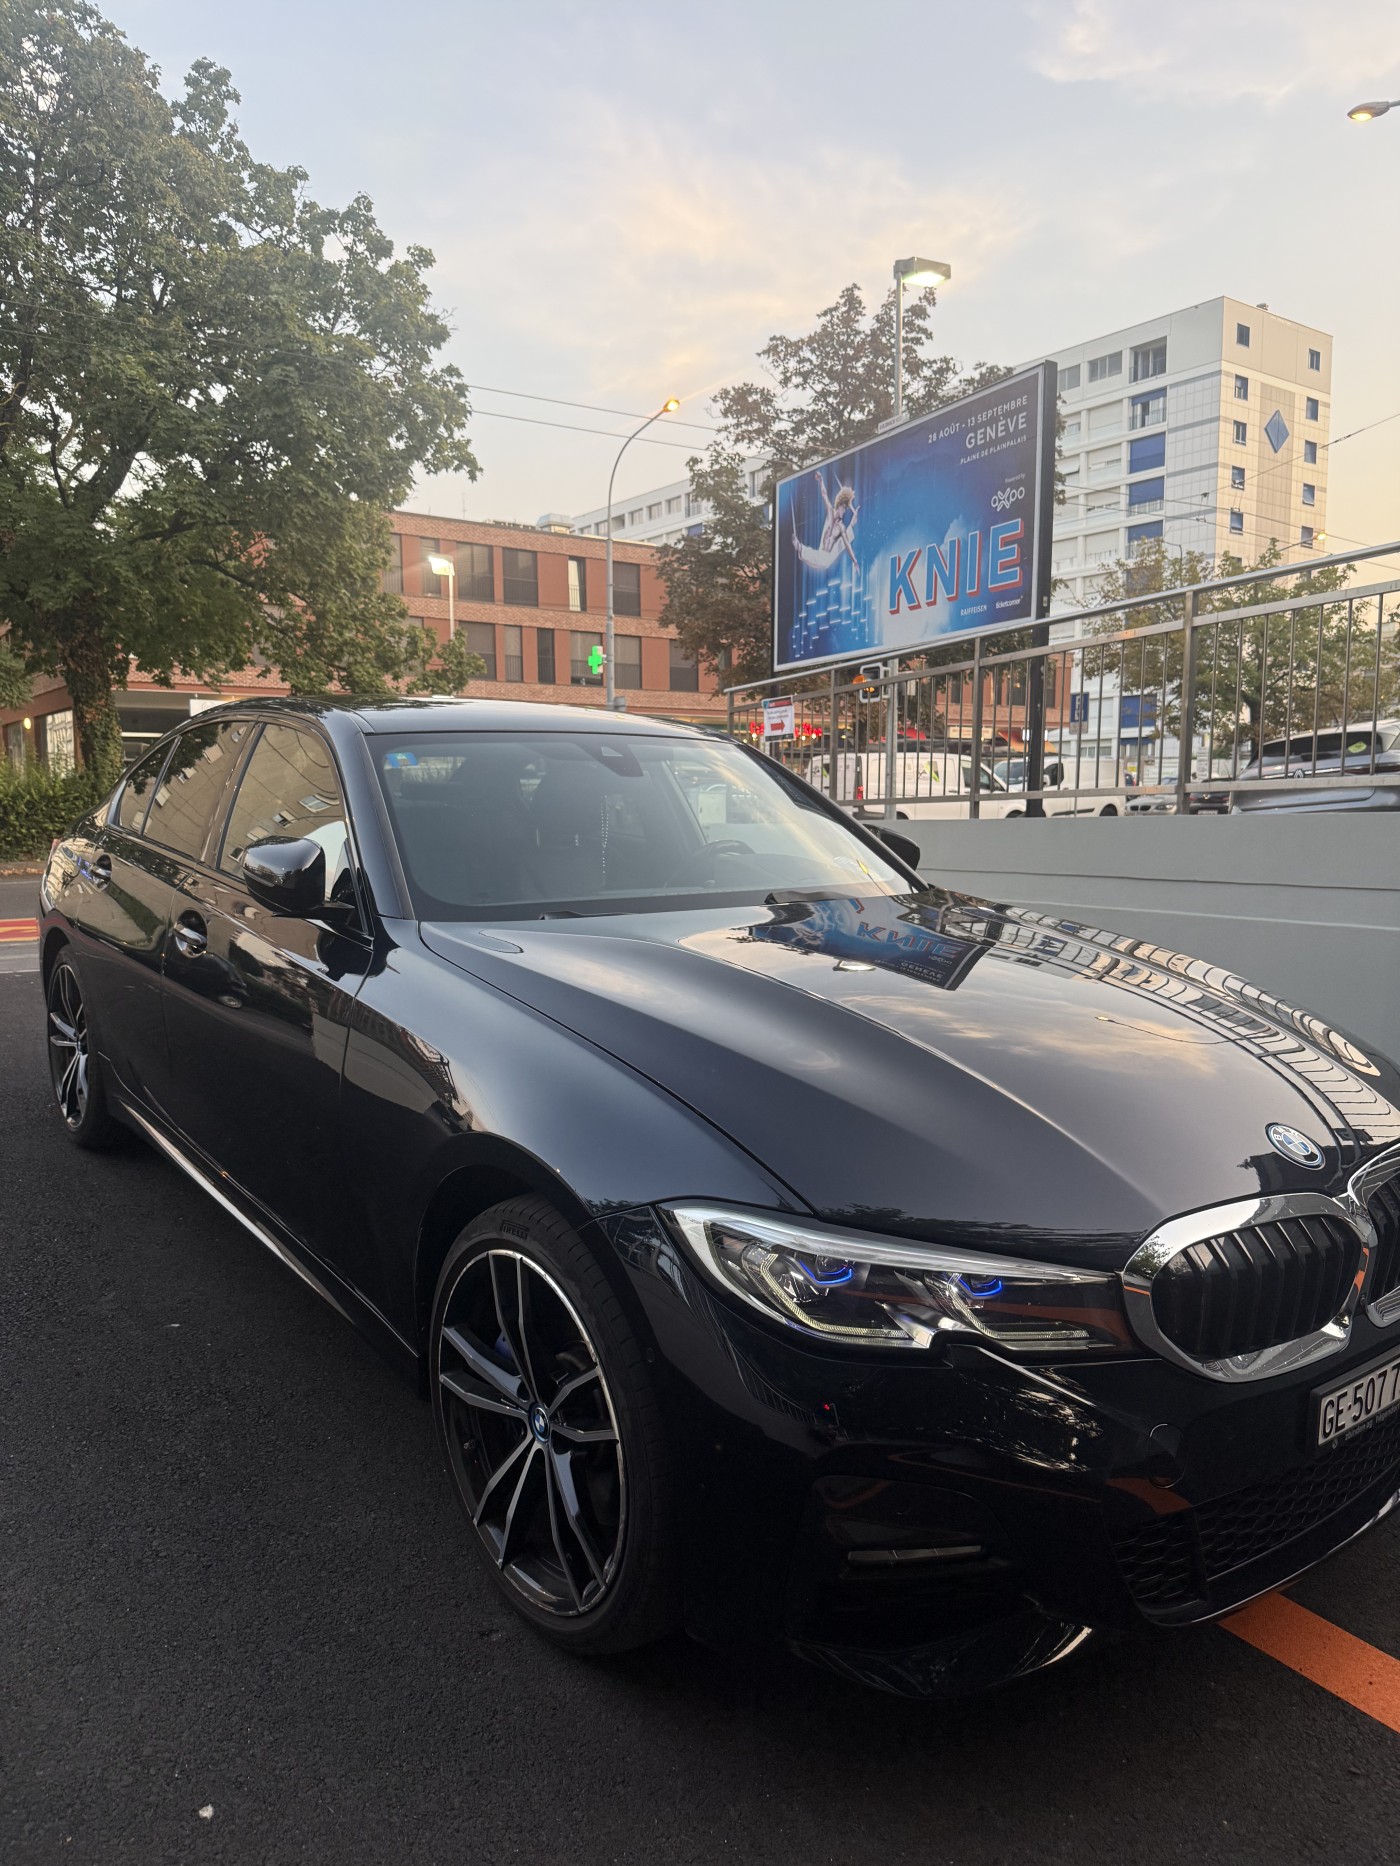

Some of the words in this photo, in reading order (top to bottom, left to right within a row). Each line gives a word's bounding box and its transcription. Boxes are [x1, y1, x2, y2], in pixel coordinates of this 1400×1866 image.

[928, 432, 937, 443] 28
[938, 422, 960, 440] AOÛT
[967, 416, 975, 428] 13
[977, 395, 1028, 423] SEPTEMBRE
[965, 411, 1027, 449] GENÈVE
[960, 451, 980, 464] PLAINE
[981, 448, 988, 458] DE
[989, 434, 1027, 455] PLAINPALAIS
[888, 517, 1025, 615] KNIE
[960, 604, 987, 617] RAIFFEISEN
[995, 597, 1023, 609] ticketcorner
